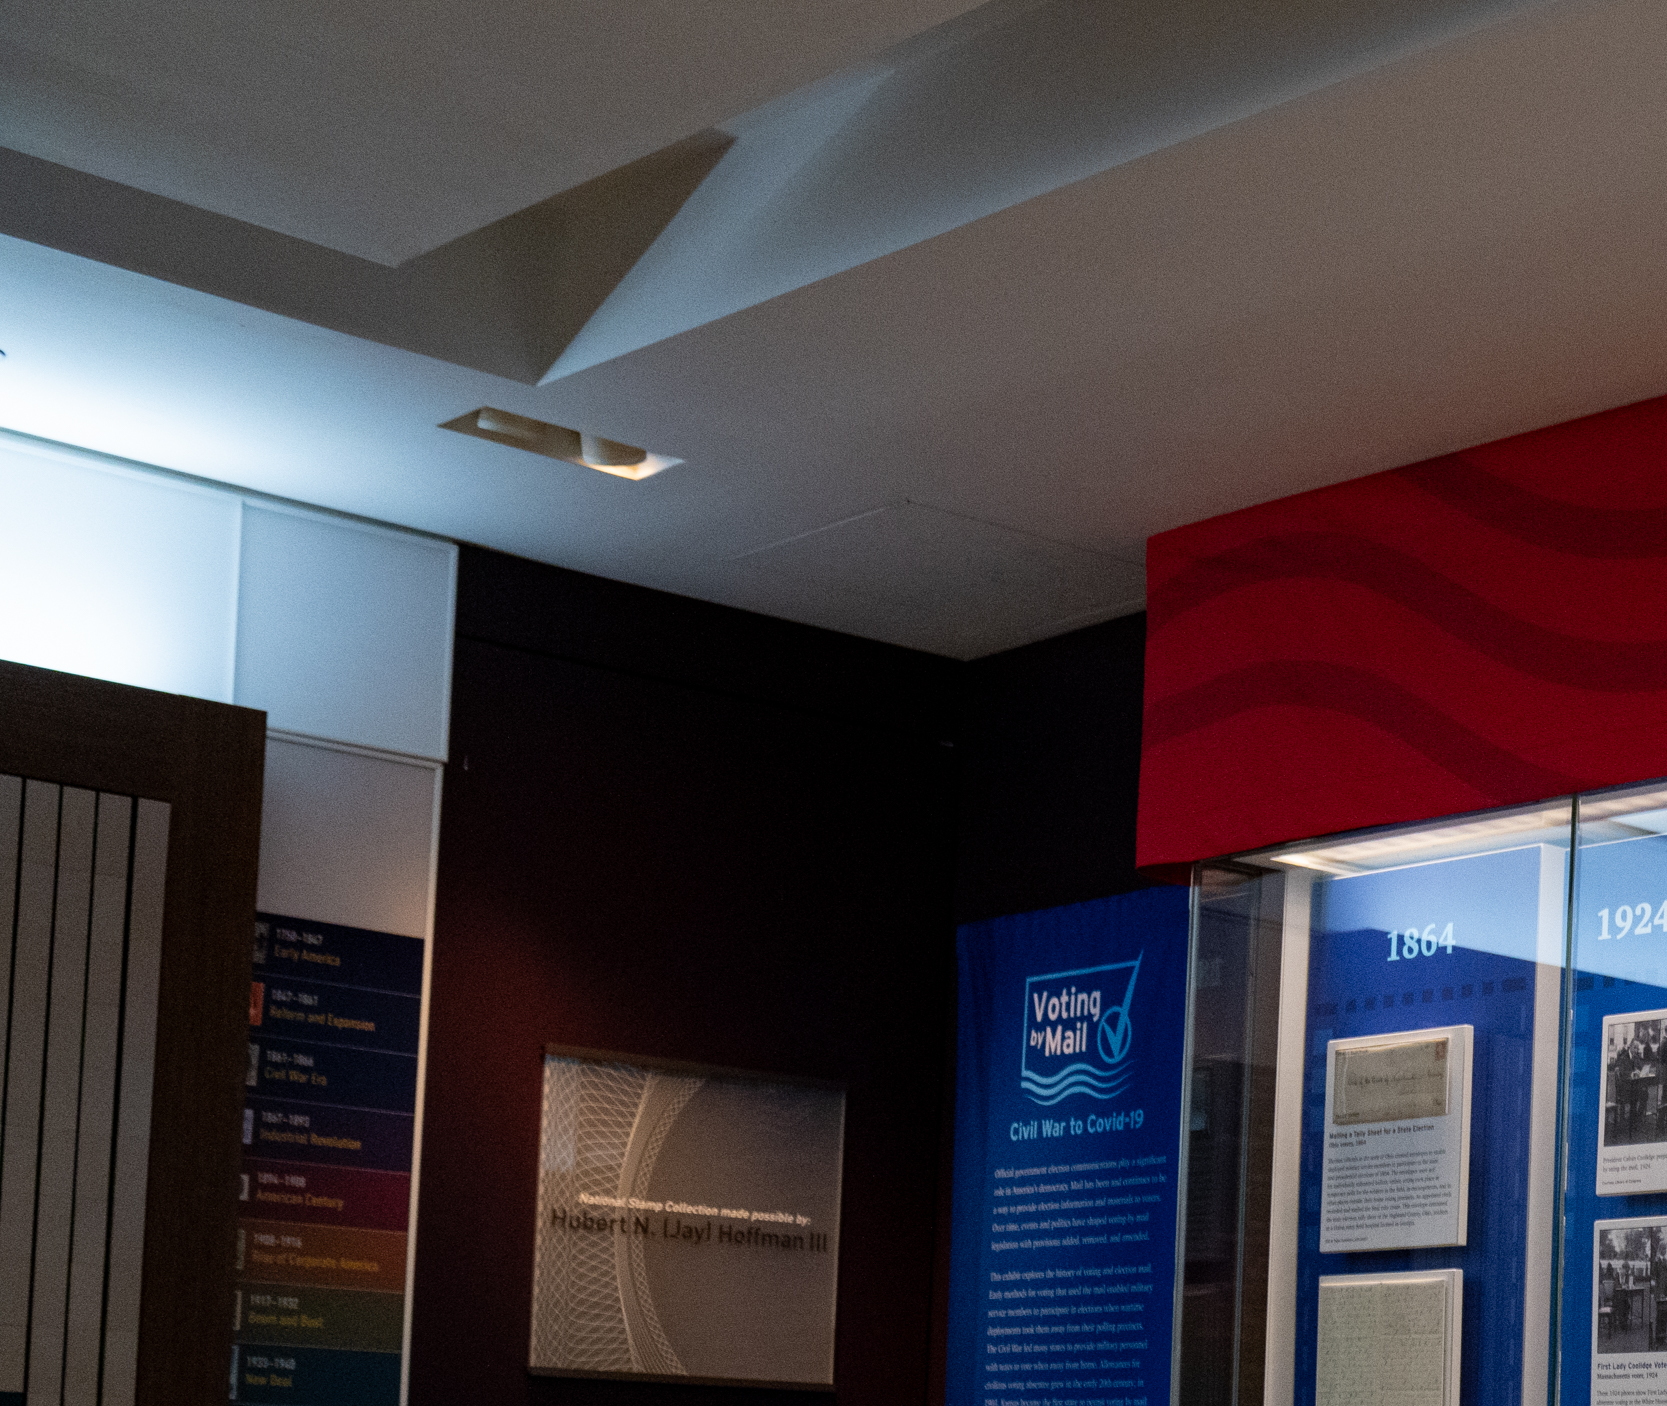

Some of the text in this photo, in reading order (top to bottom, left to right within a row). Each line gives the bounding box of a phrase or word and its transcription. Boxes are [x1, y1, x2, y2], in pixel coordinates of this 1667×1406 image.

[1387, 922, 1456, 962] 1864
[1033, 988, 1101, 1023] Voting
[1030, 1022, 1088, 1057] by Mail
[1010, 1110, 1143, 1141] Civil War to Covid-19
[628, 1198, 663, 1213] Stamp
[665, 1200, 718, 1217] Collection
[721, 1206, 750, 1220] made
[751, 1209, 794, 1225] possible
[795, 1213, 811, 1227] by:
[551, 1209, 627, 1233] Hubert
[634, 1216, 656, 1237] N.
[719, 1224, 804, 1250] Hoffman
[809, 1232, 828, 1252] III
